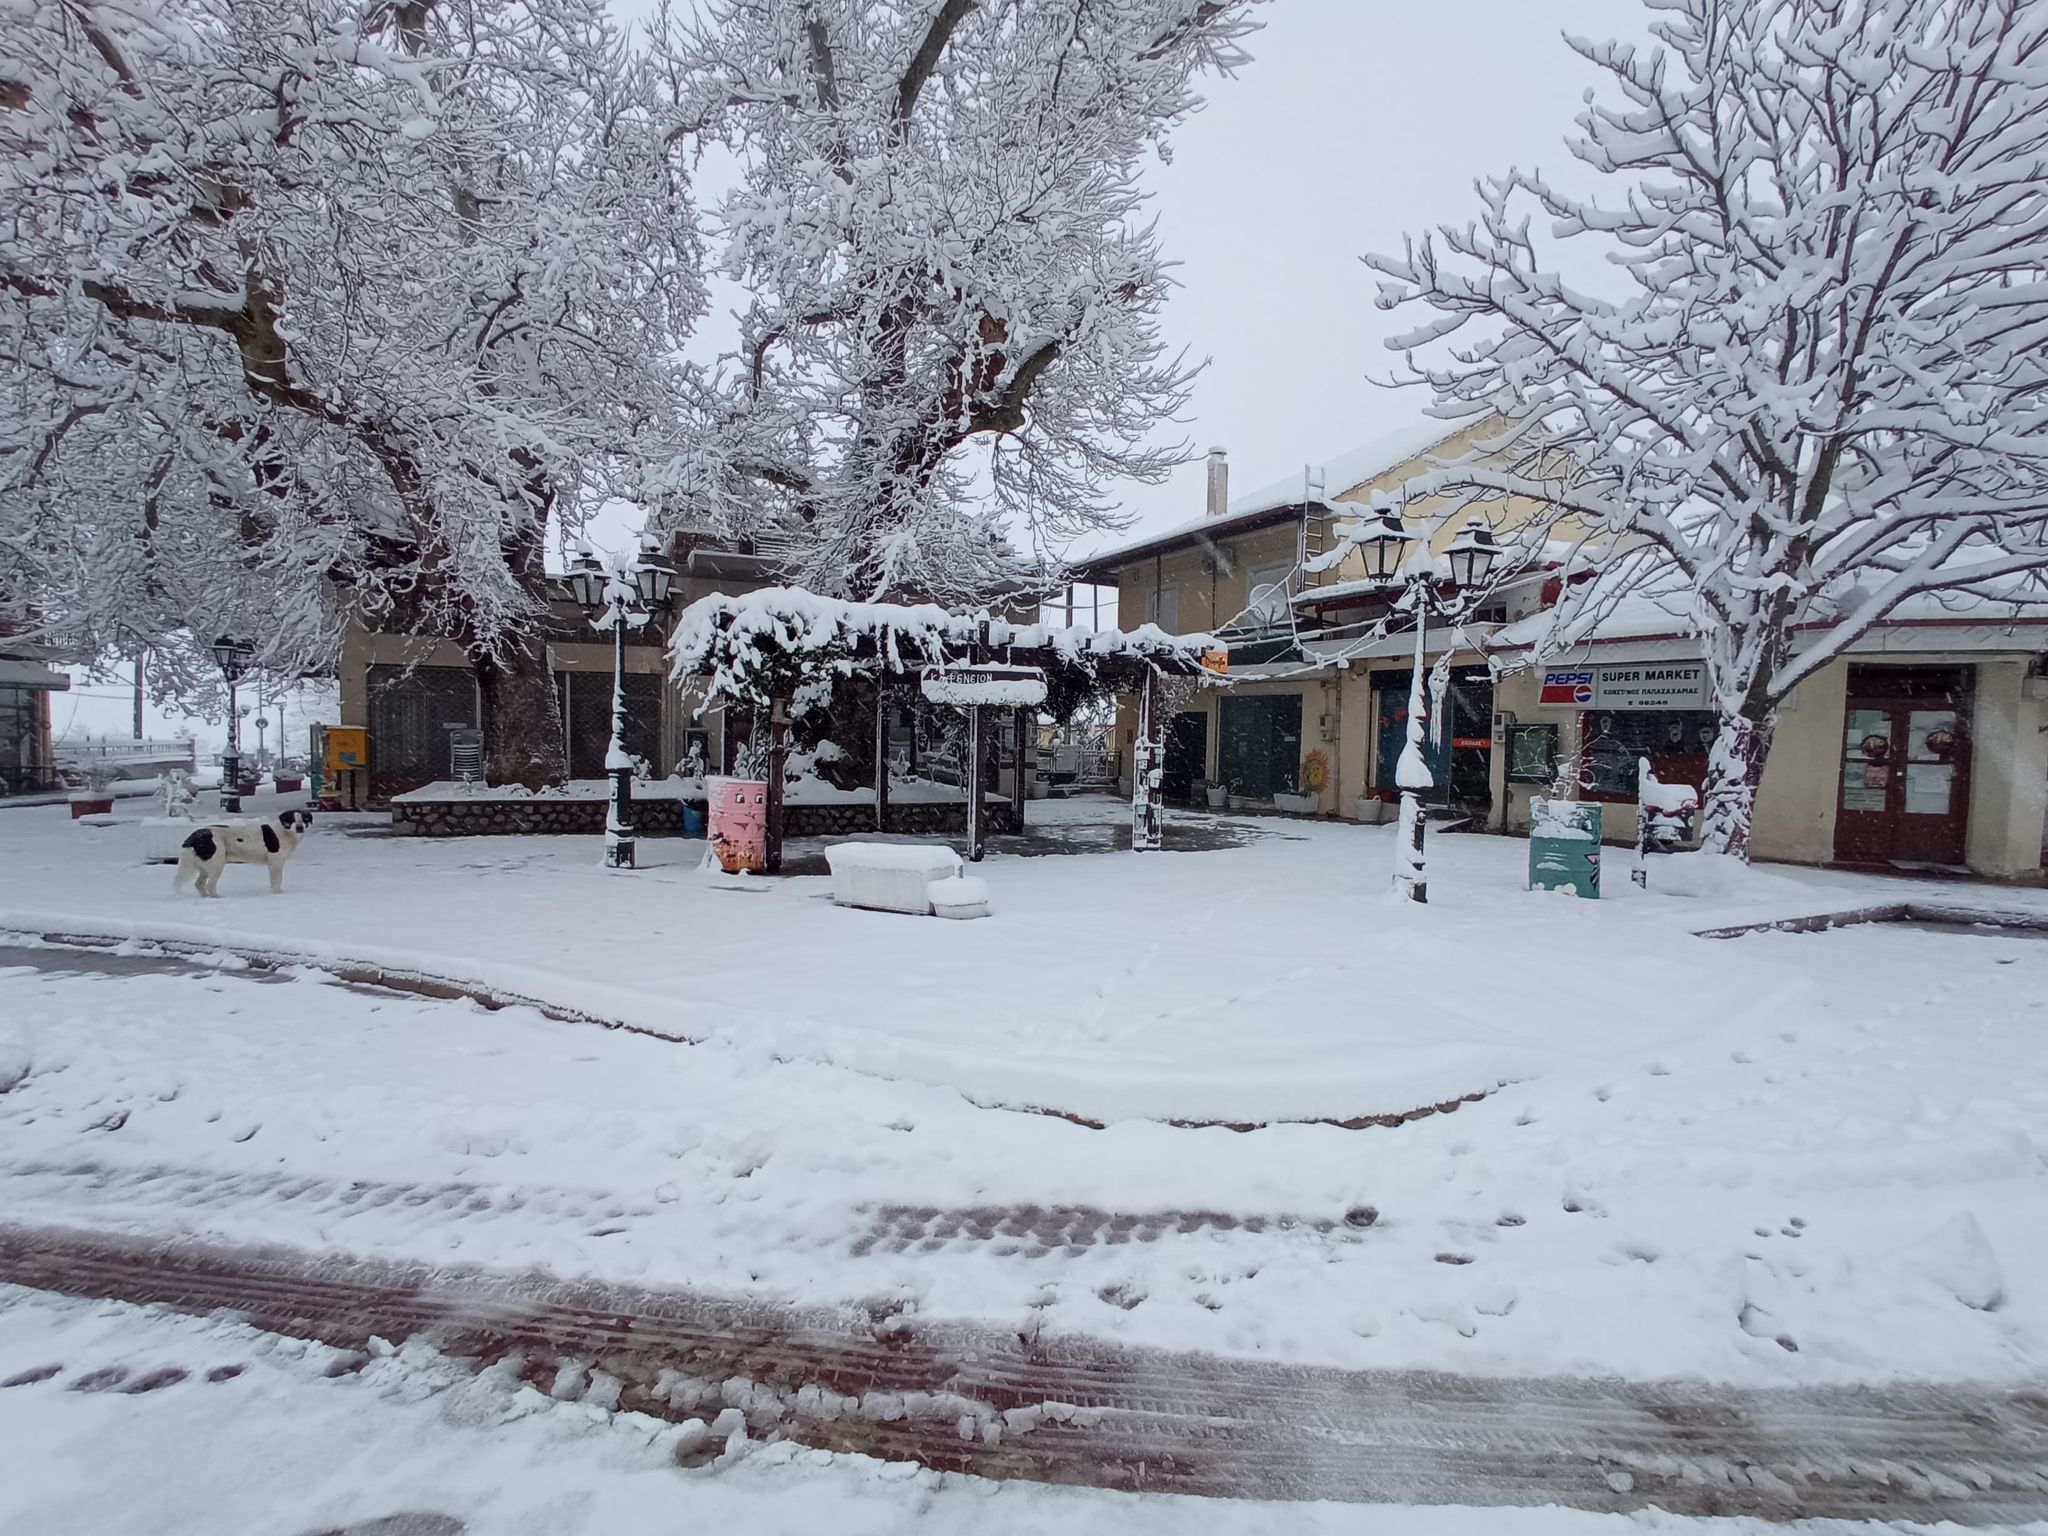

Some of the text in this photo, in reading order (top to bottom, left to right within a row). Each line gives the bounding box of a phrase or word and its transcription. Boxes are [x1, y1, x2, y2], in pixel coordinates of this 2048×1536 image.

[1544, 673, 1593, 684] PEPSI
[1602, 670, 1700, 681] SUPER MARKET
